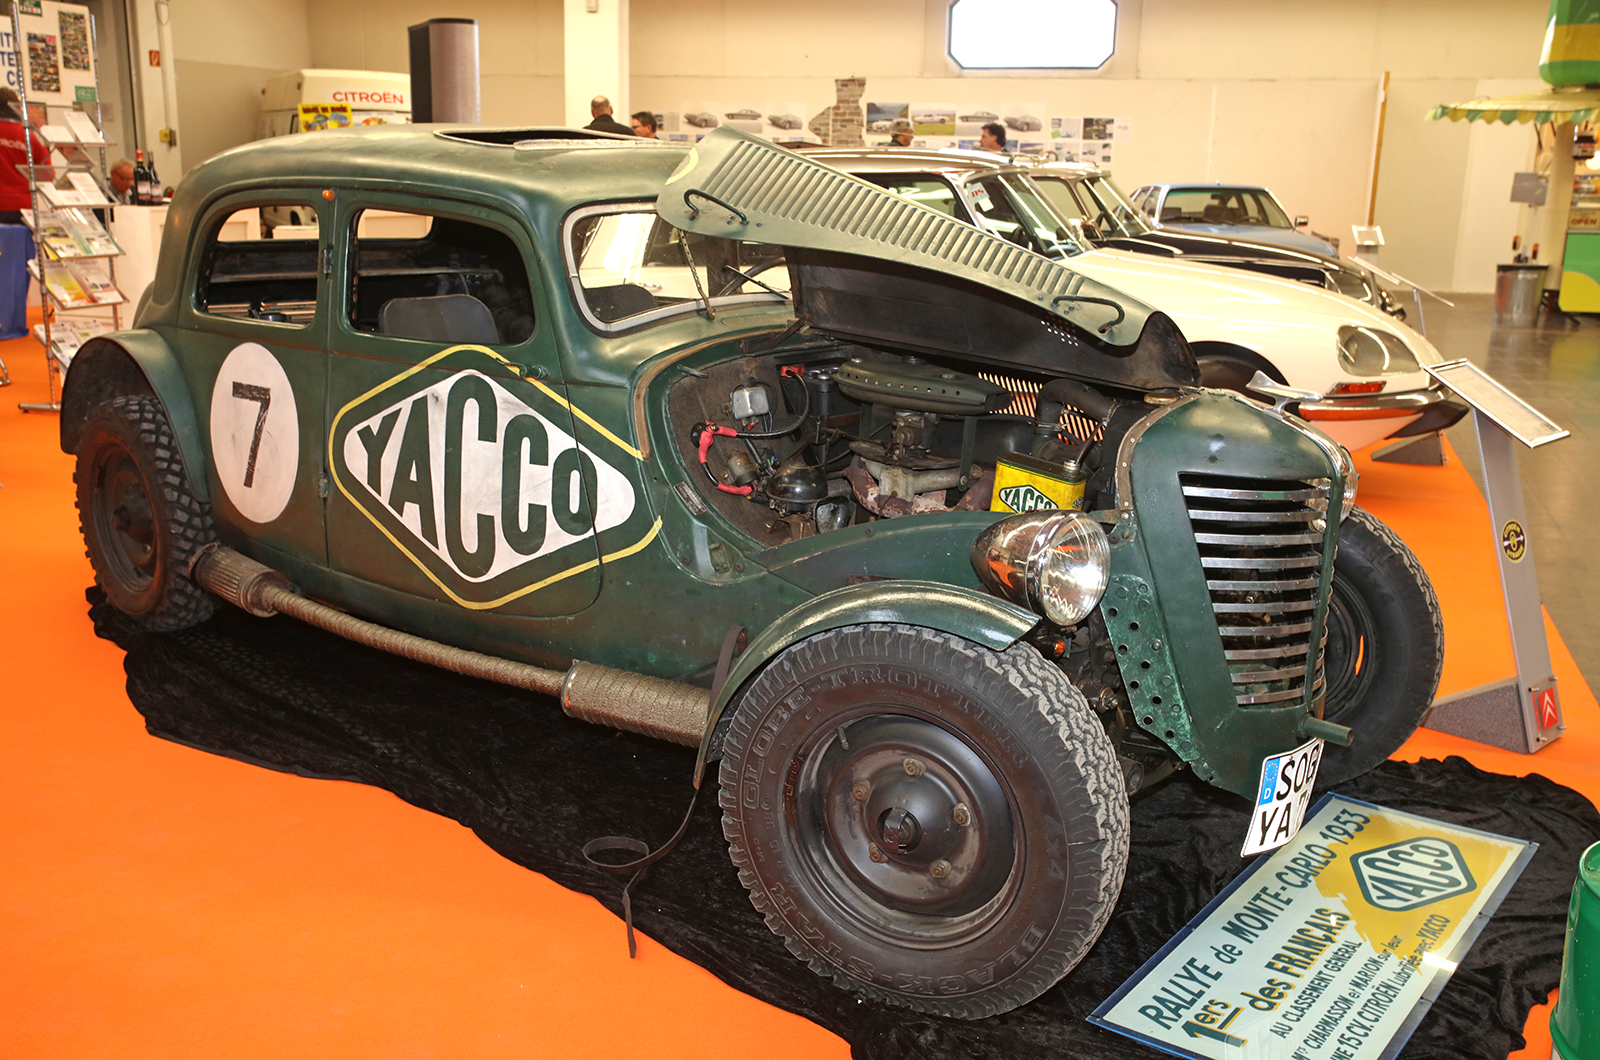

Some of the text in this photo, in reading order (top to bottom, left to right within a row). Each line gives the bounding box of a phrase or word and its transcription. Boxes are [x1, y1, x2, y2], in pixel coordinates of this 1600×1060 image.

[332, 91, 405, 105] CITROËN
[232, 381, 271, 488] 7
[356, 374, 598, 579] YACCO
[1263, 788, 1272, 800] D
[1259, 801, 1292, 847] YA
[1363, 843, 1462, 903] YACCO
[1137, 808, 1371, 1031] RALLYE de MONTE-CARLO 1953
[1348, 956, 1386, 991] MARION
[1377, 948, 1393, 962] sur
[1239, 977, 1297, 1012] des
[1281, 970, 1336, 1022] CLASSEMENT
[1337, 1032, 1363, 1050] 15
[1357, 981, 1402, 1023] CITROËN
[1415, 913, 1451, 942] YACCO
[1347, 987, 1362, 999] et
[1269, 1021, 1294, 1039] AU
[1302, 994, 1355, 1050] CHARMASSON
